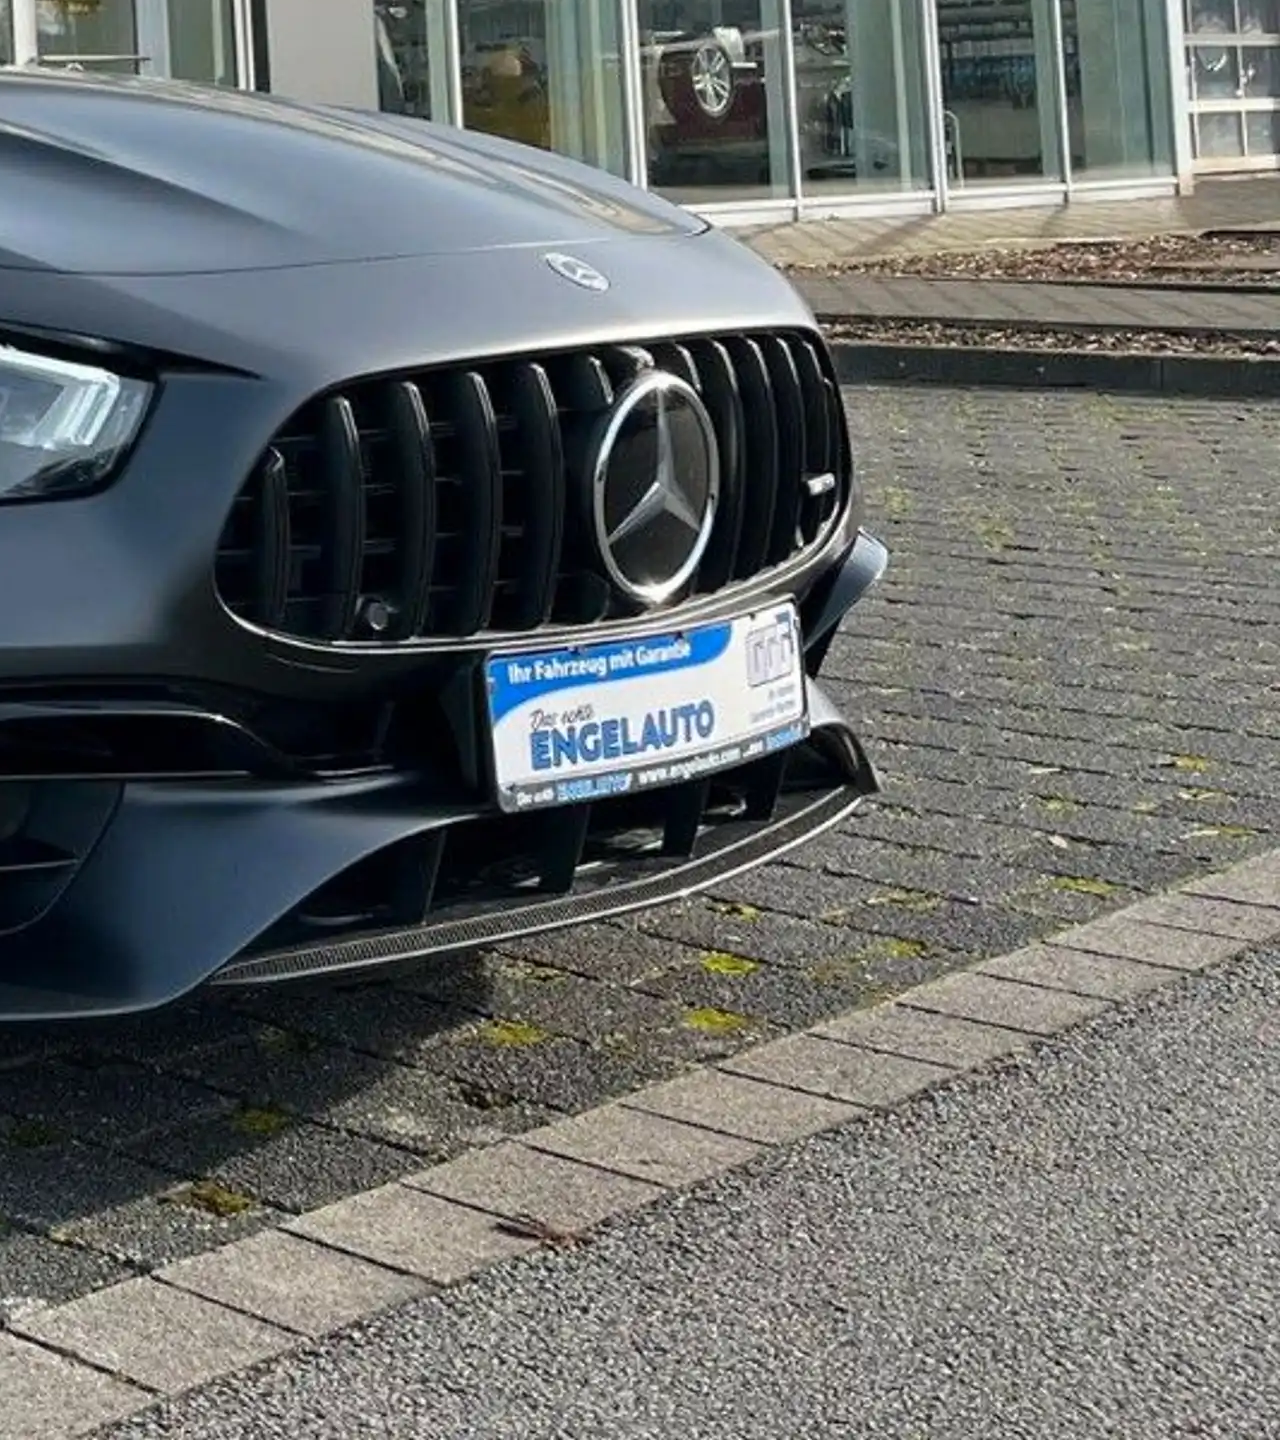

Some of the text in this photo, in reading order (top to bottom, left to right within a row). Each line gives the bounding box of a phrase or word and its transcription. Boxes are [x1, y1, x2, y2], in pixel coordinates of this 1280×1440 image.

[508, 663, 531, 684] Ihr
[534, 656, 608, 680] Fahrzeug
[610, 649, 635, 669] mit
[529, 699, 716, 771] ENGELAUTO
